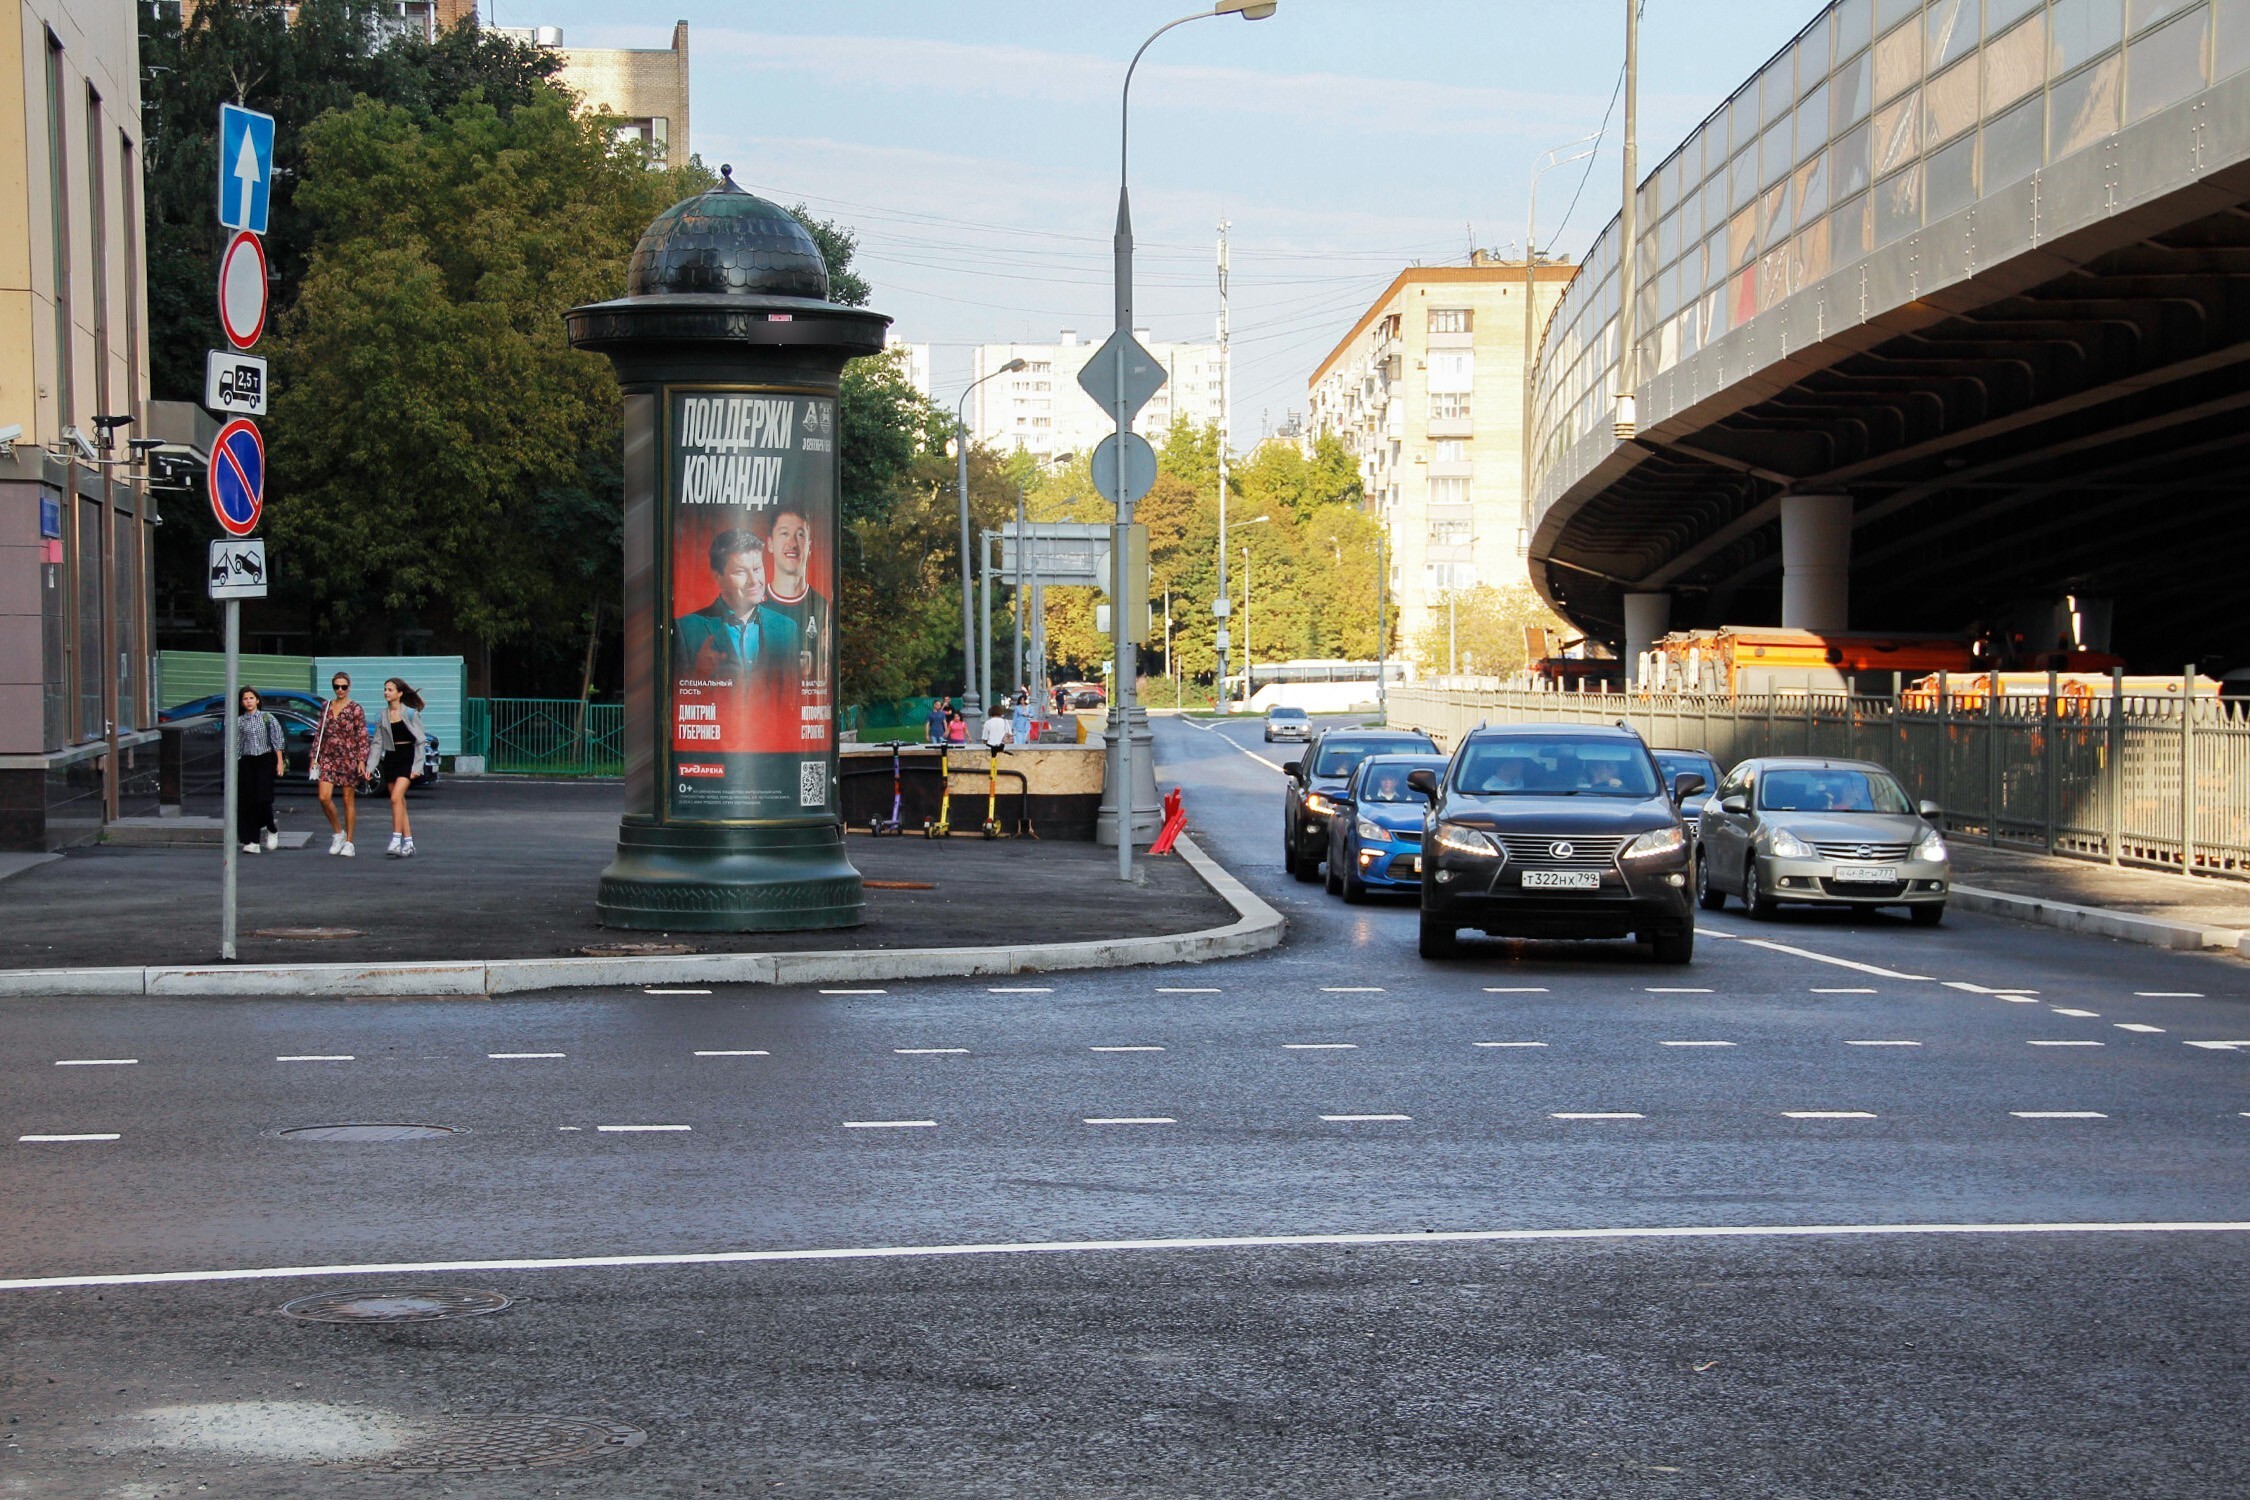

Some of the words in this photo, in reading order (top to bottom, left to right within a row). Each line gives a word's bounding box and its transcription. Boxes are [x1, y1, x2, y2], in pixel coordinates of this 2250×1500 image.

[682, 398, 794, 454] ПОДДЕРЖИ
[682, 455, 782, 511] КОМАНДУ!
[679, 679, 733, 687] СПЕЦИАЛЬНЫЙ
[679, 702, 716, 722] ДМИТРИЙ
[679, 724, 721, 740] ГУБЕРНИЕВ
[700, 766, 724, 774] АРЕНА
[679, 783, 693, 793] 0+
